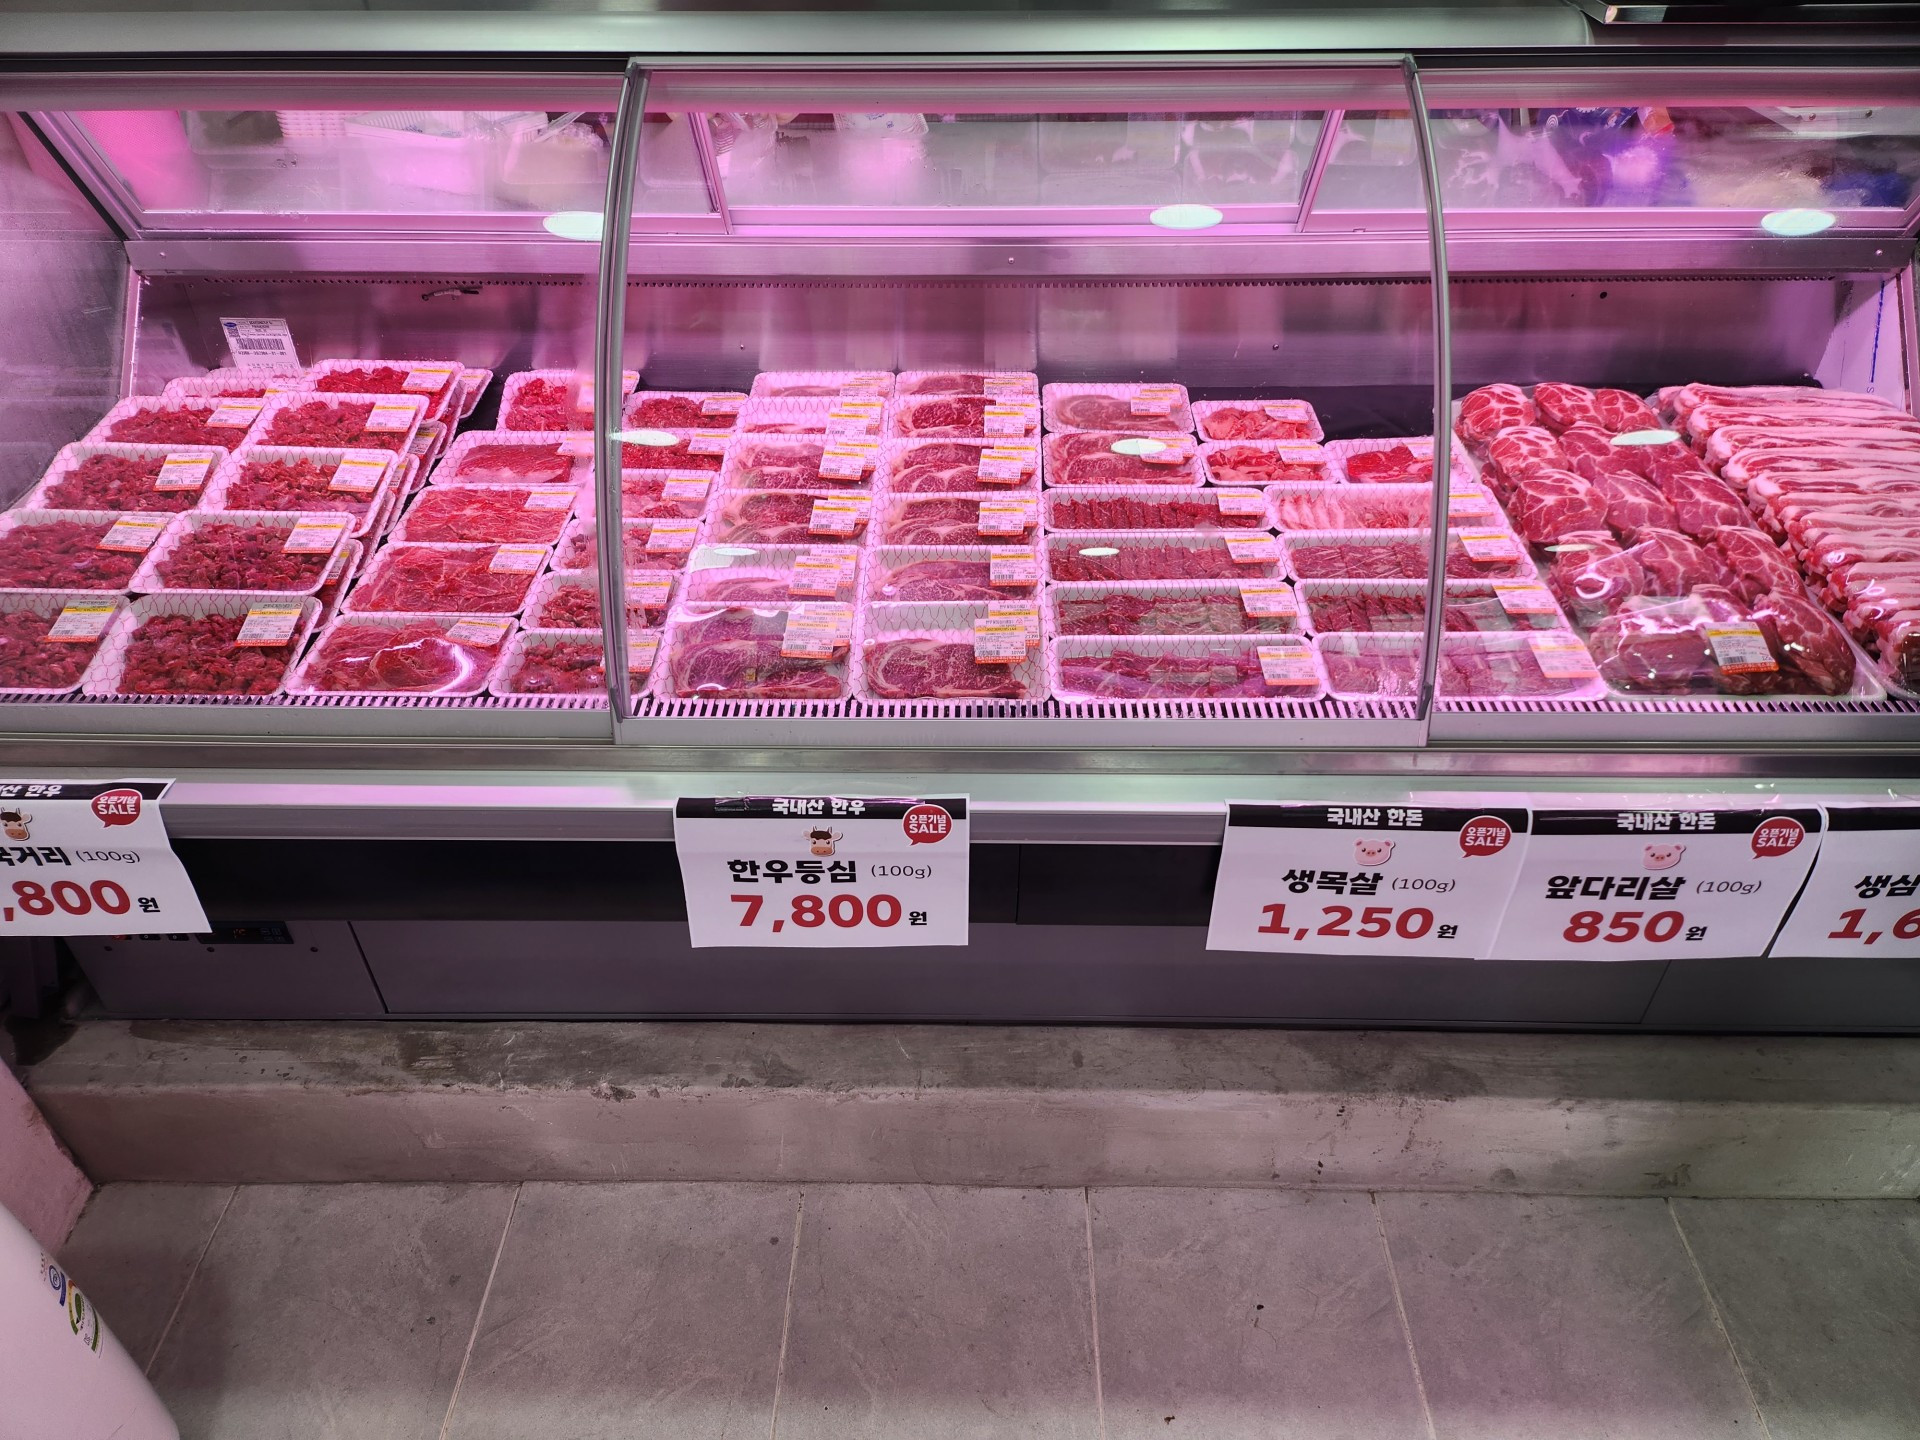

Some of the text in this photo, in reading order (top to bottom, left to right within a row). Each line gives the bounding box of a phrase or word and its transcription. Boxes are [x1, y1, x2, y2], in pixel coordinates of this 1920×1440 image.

[24, 785, 62, 797] 한우
[97, 796, 137, 805] 오픈기념
[772, 799, 866, 815] 국내산 한우
[98, 805, 137, 815] SALE
[1327, 807, 1423, 826] 국내산 한돈
[909, 814, 947, 824] 오픈기념
[1617, 812, 1717, 831] 국내산 한돈
[909, 823, 946, 834] SALE
[1466, 827, 1506, 837] 오픈기념
[1759, 828, 1799, 839] 오픈기념
[1465, 835, 1504, 847] SALE
[1756, 837, 1797, 848] SALE
[76, 850, 140, 864] (100g)
[727, 859, 932, 884] 한우등심 (100g)
[1282, 869, 1456, 895] 생목살 (100g)
[1545, 875, 1762, 901] 앞다리살 (100g)
[138, 897, 160, 913] 원
[730, 894, 927, 933] 7,800 원
[1258, 903, 1457, 941] 1,250 원
[1562, 911, 1707, 943] 850 원
